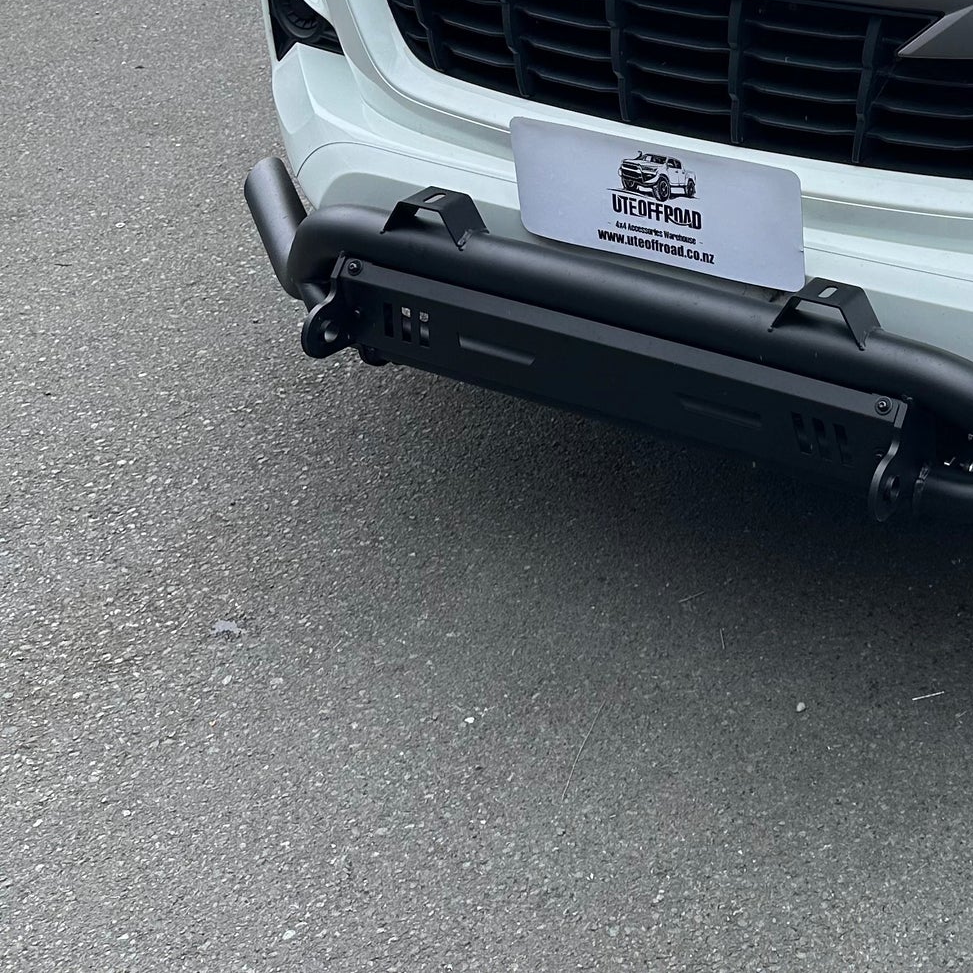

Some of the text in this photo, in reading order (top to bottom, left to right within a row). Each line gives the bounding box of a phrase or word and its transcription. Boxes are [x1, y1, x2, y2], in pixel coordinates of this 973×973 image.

[612, 193, 702, 230] UTEOFFROAD
[598, 229, 715, 265] www.uteoffroad.co.nz
[615, 220, 697, 245] 4x4 Accessories Warehouse
